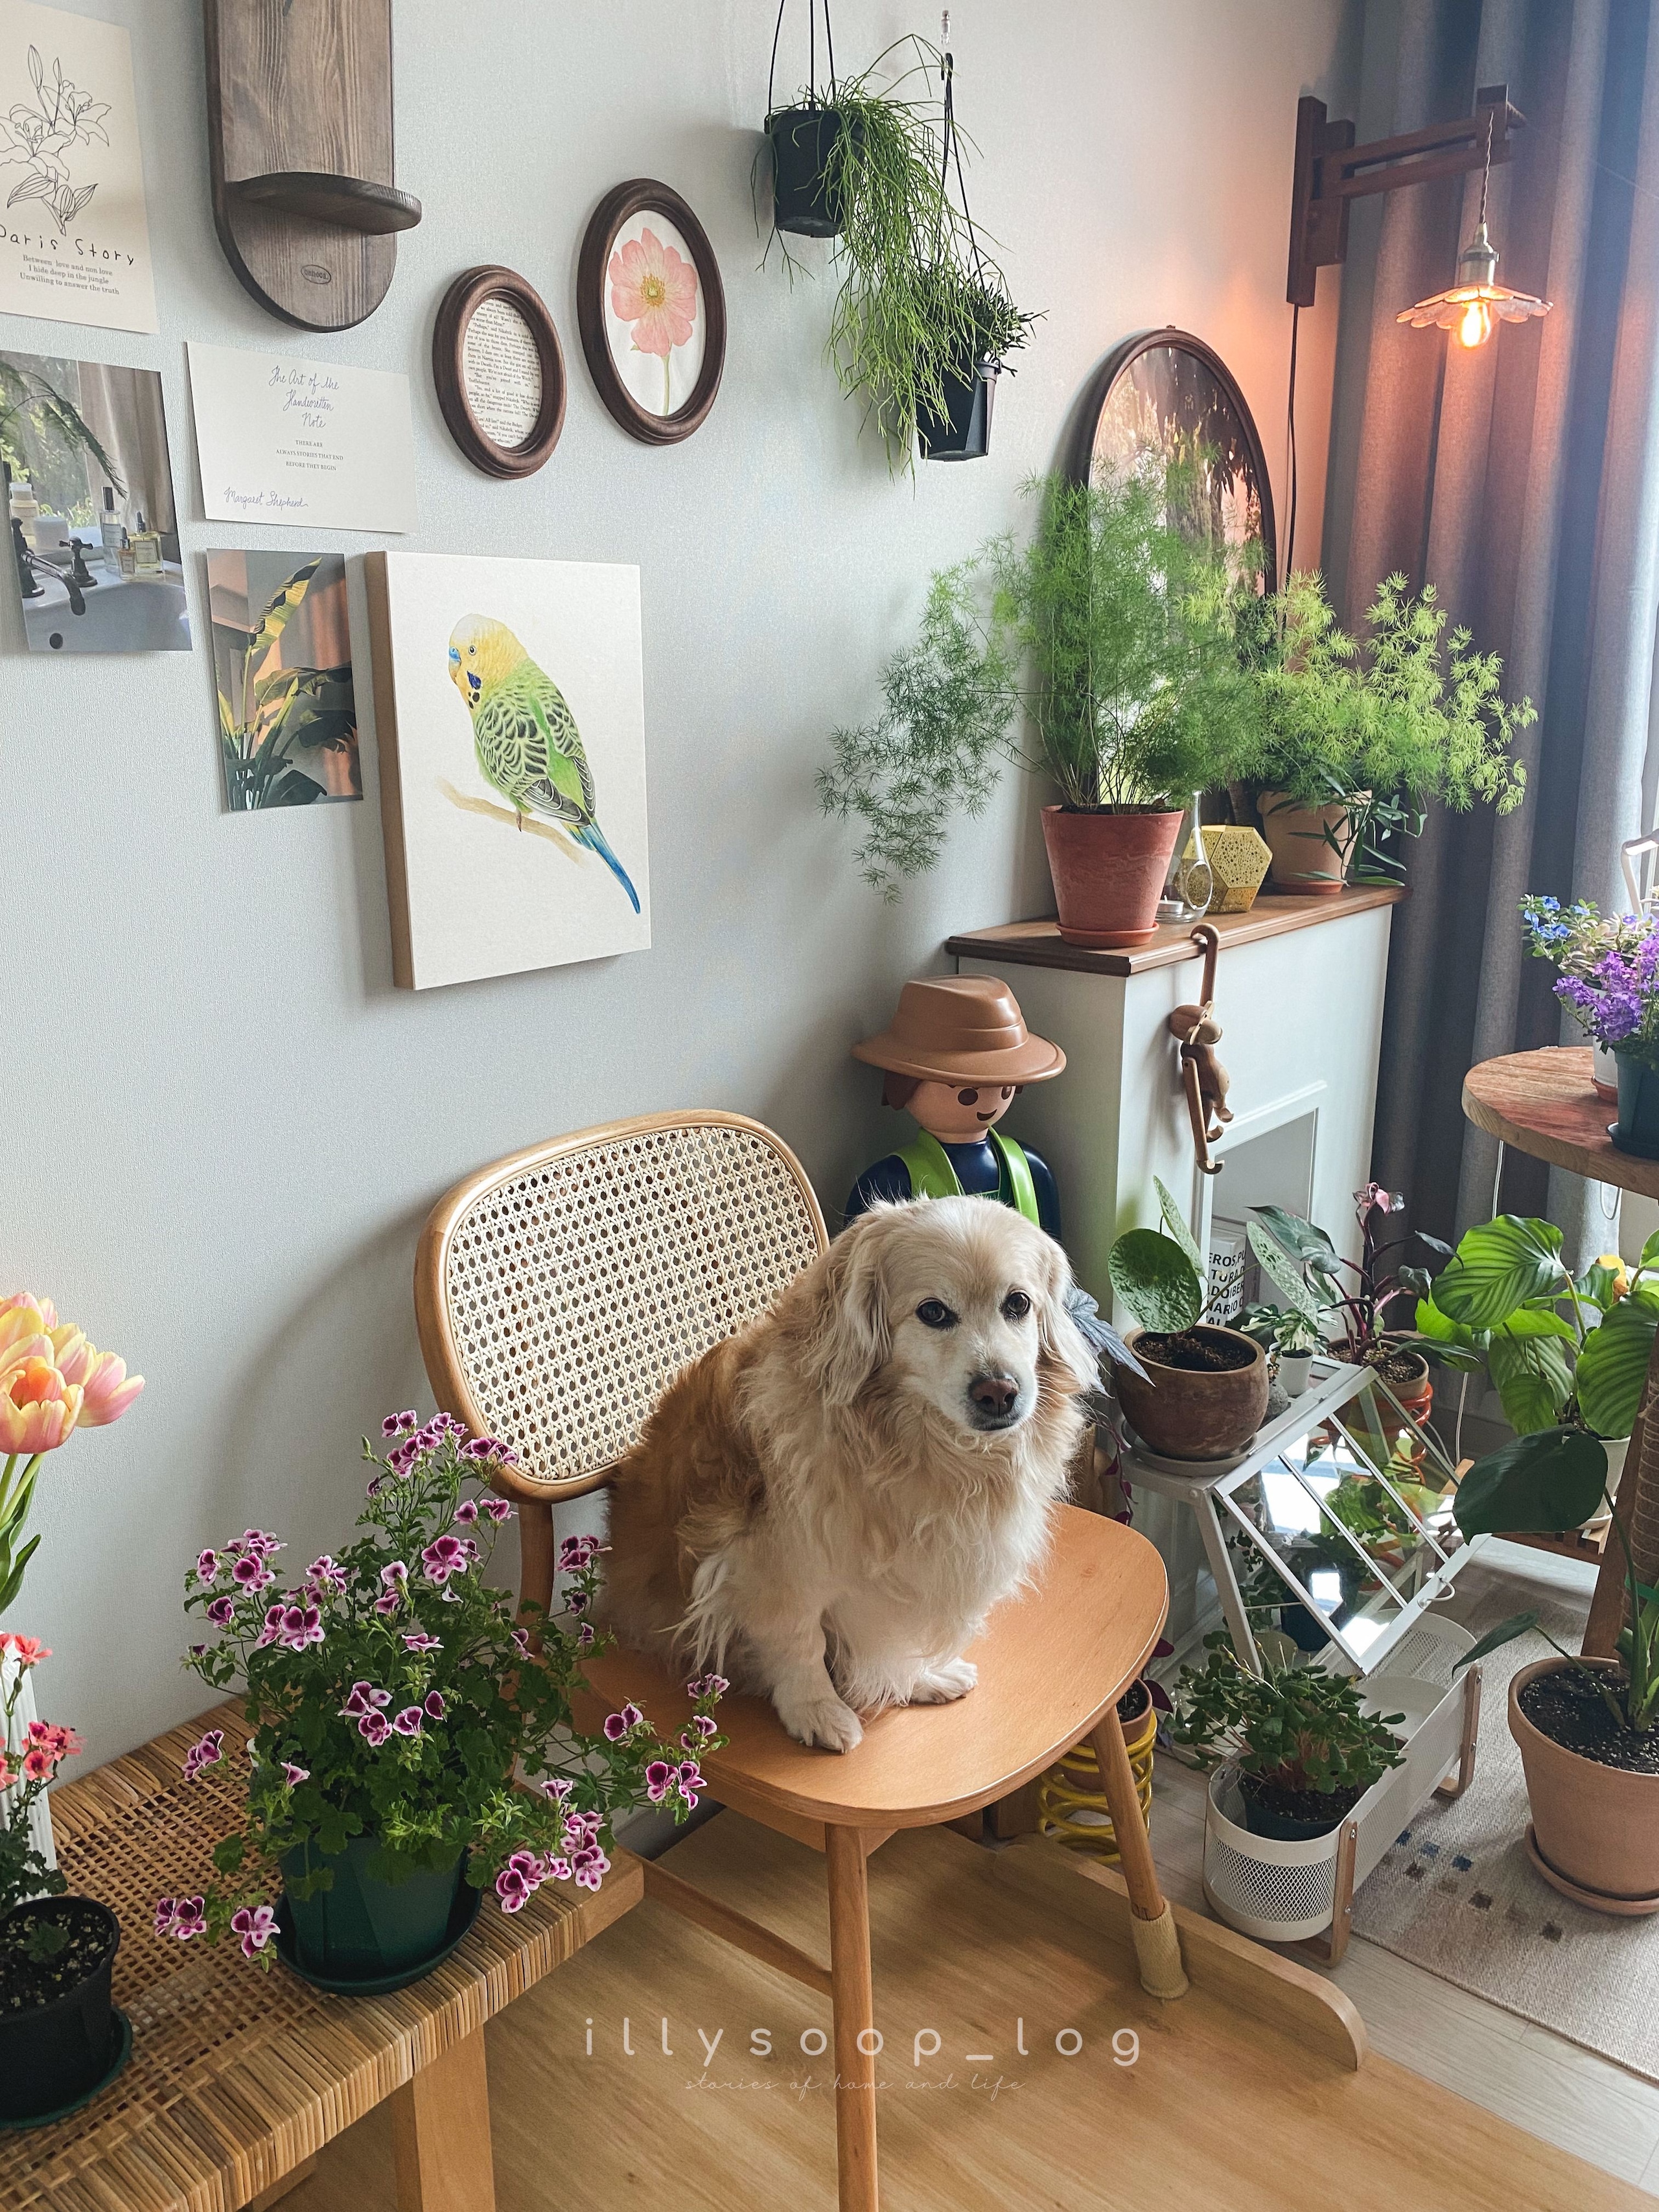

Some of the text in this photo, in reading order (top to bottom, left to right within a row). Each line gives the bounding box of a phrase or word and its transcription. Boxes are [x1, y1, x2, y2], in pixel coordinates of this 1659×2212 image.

[75, 239, 133, 266] Story
[23, 254, 52, 266] Between
[56, 259, 69, 268] love
[99, 267, 113, 276] love
[34, 264, 49, 274] hide
[50, 268, 66, 279] deep
[76, 272, 87, 281] the
[88, 274, 109, 285] jungle
[20, 272, 54, 286] Unwilling
[64, 281, 88, 290] answer
[89, 284, 100, 292] the
[102, 286, 119, 295] truth
[268, 365, 340, 395] The Art of the
[283, 389, 334, 412] Handwritten
[301, 412, 326, 428] Note
[224, 486, 308, 511] Margaret Shepherd
